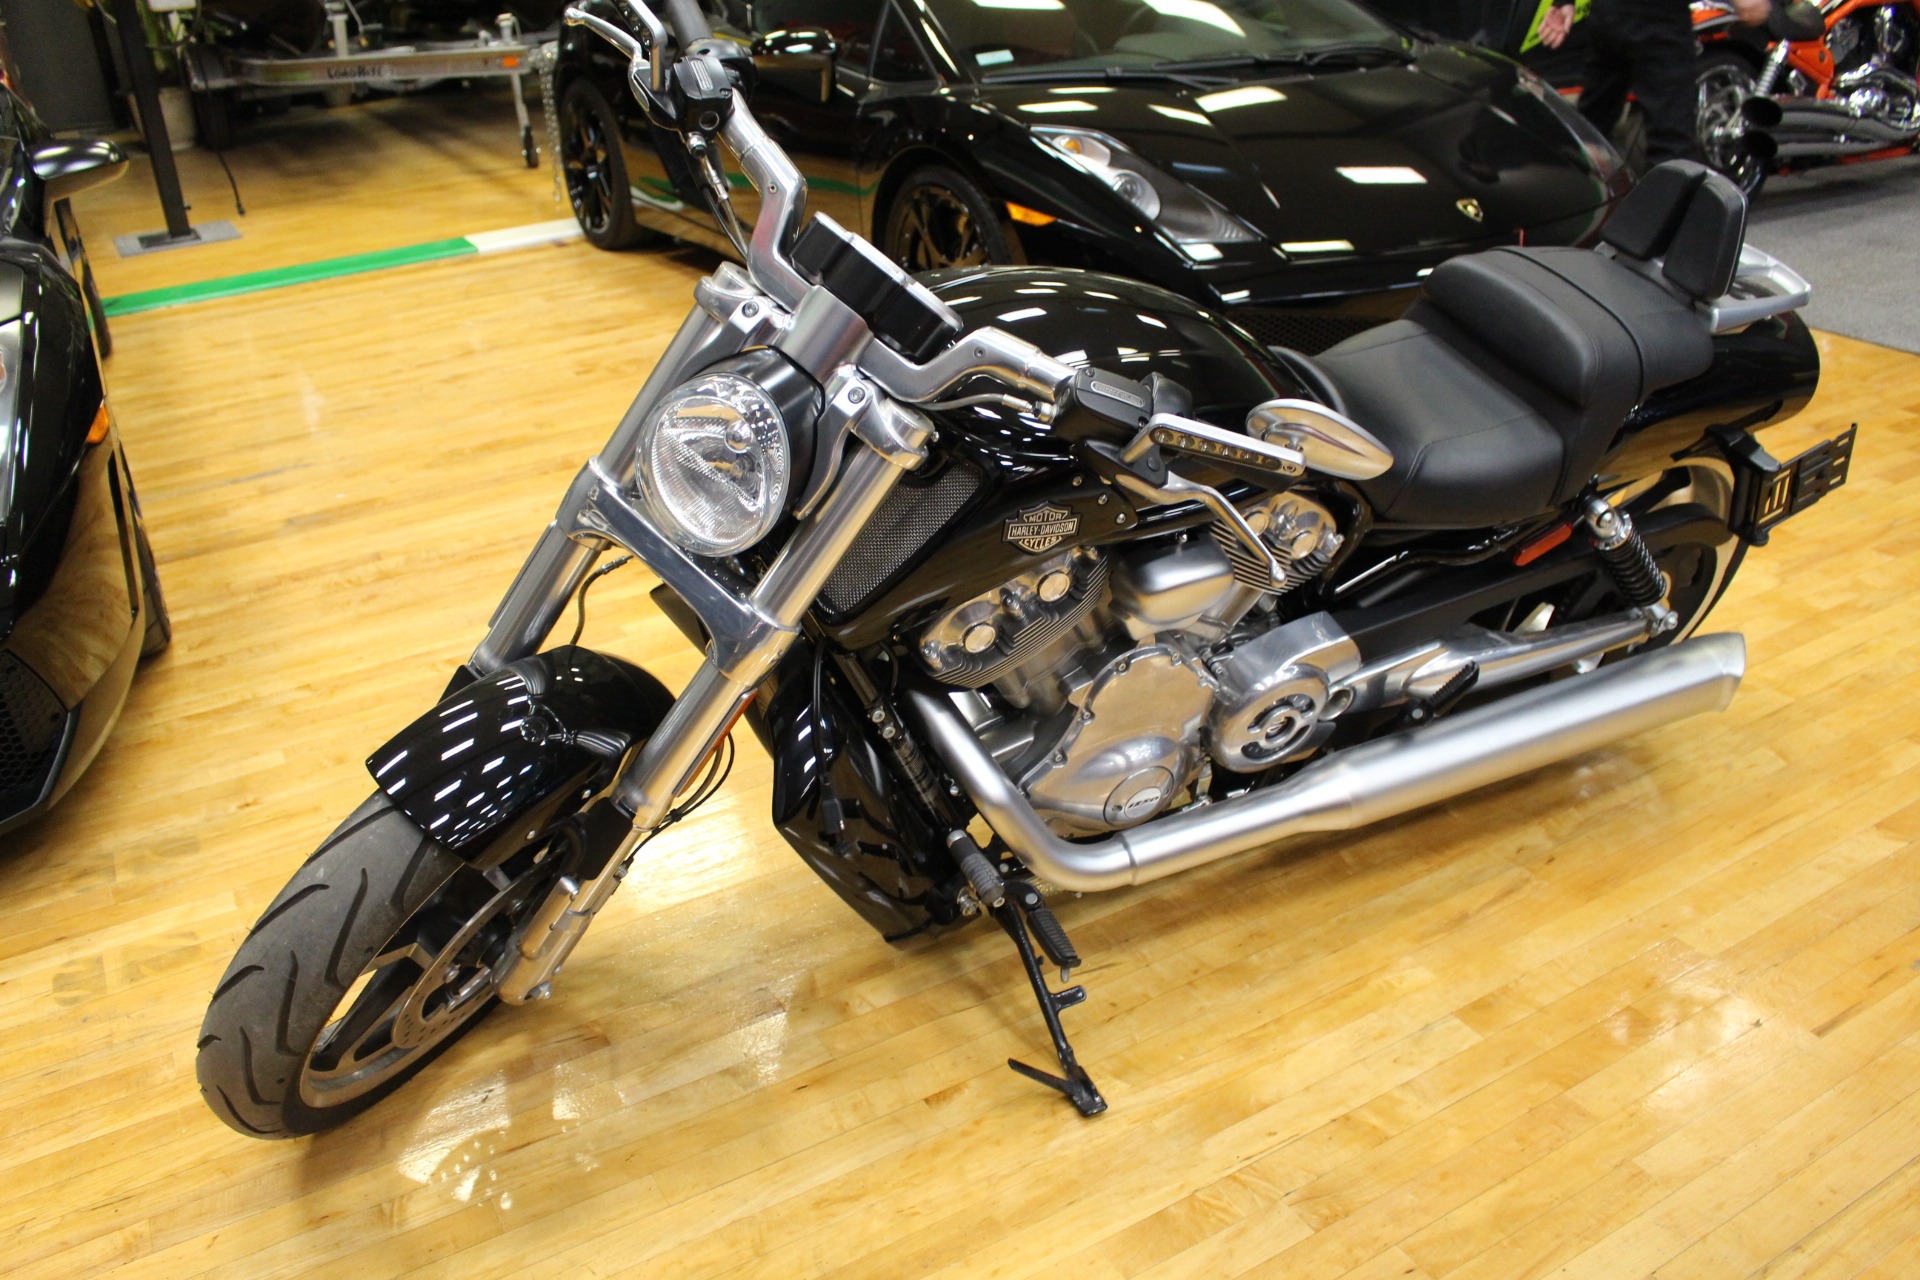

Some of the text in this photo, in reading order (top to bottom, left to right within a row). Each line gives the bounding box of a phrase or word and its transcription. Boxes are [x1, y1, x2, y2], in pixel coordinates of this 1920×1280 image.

[1028, 509, 1062, 523] MOTOR
[1011, 520, 1074, 537] HARLEY-DAVIDSON
[1024, 536, 1057, 550] CYCLES
